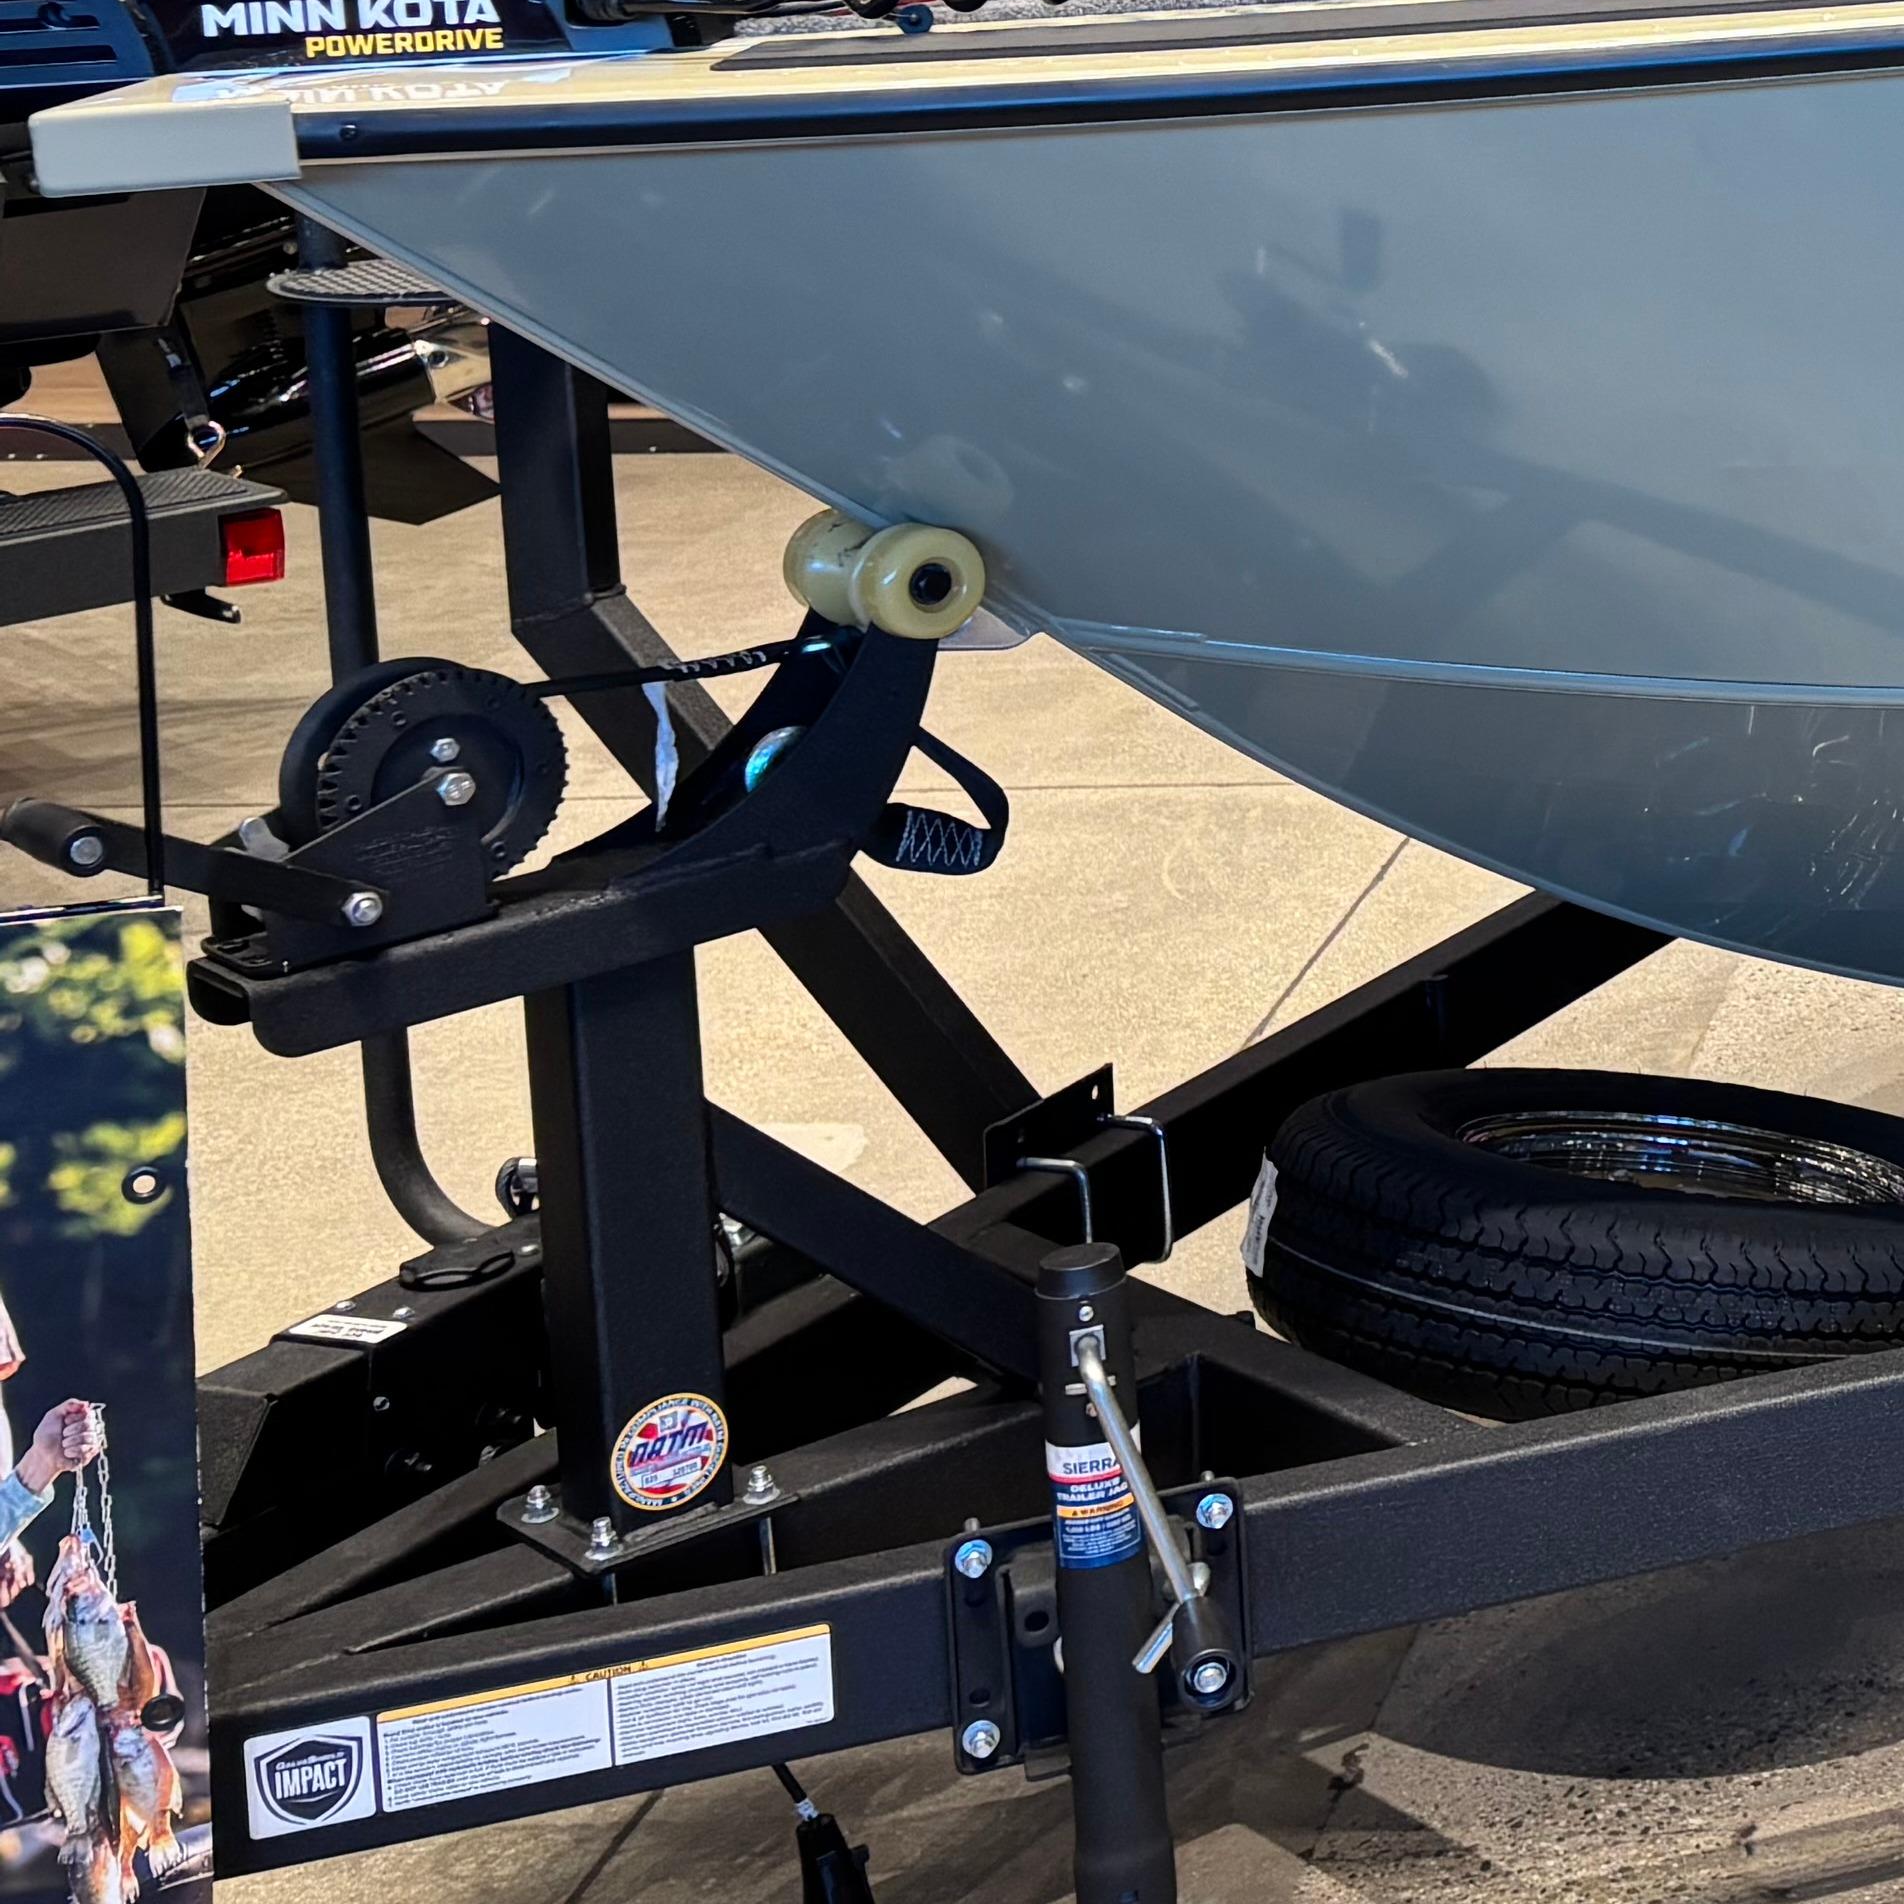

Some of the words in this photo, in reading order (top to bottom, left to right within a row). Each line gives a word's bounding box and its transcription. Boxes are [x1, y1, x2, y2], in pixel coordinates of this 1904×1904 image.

[305, 27, 504, 58] POWERDRIVE
[1070, 1476, 1120, 1493] DELUXE
[1056, 1490, 1106, 1502] TRAILER
[585, 1663, 631, 1681] CAUTION
[274, 1758, 347, 1799] IMPACT
